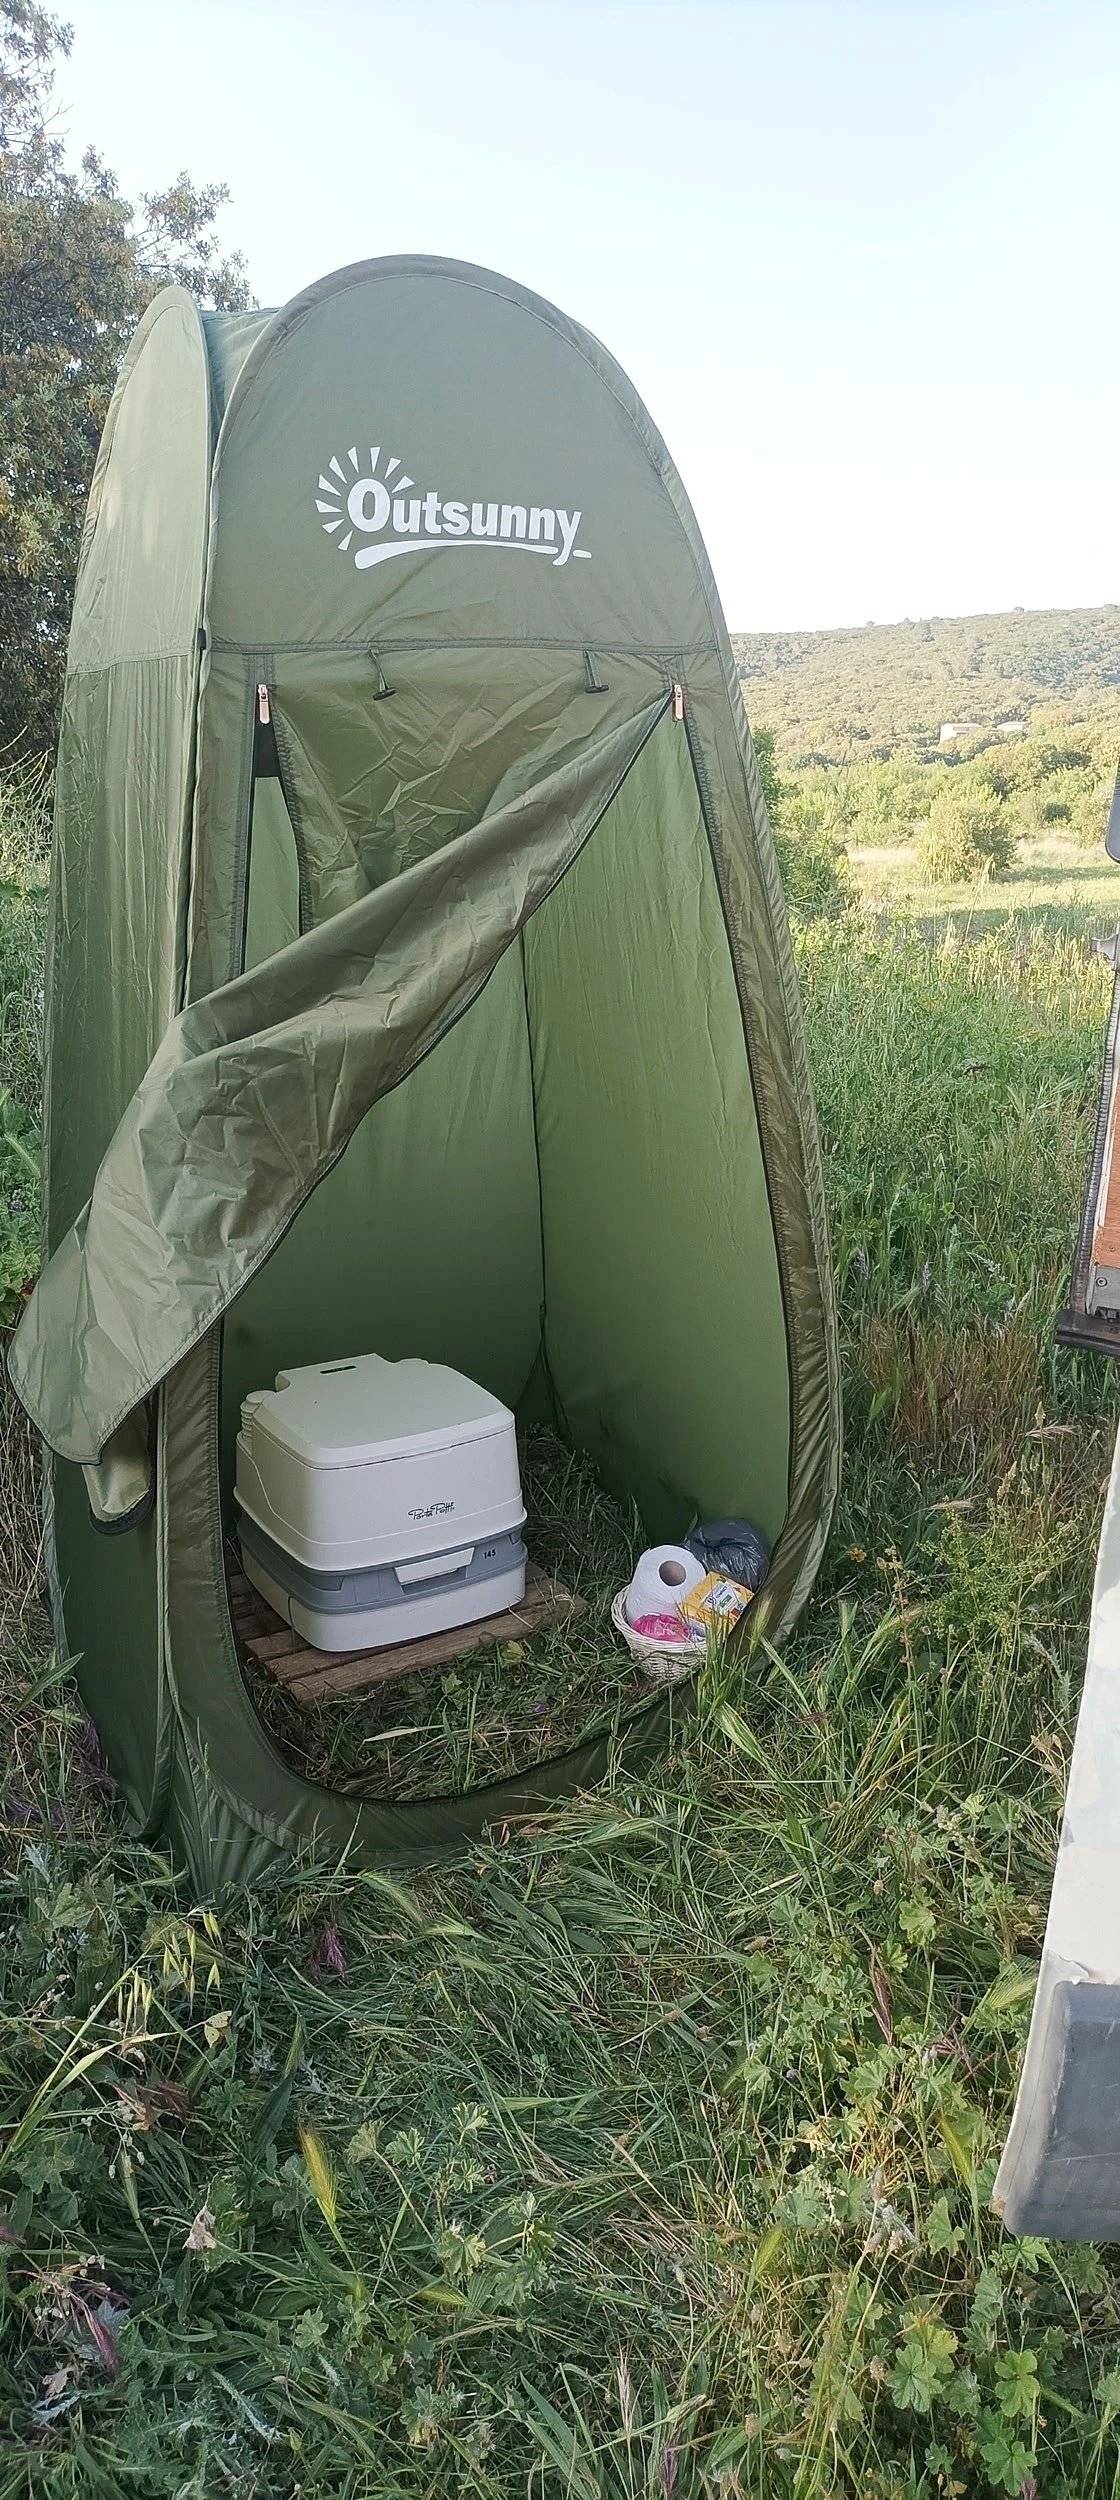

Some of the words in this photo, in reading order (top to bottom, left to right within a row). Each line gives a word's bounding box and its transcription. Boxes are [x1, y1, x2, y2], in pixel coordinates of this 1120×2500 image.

[347, 478, 582, 565] Outsunny
[408, 1508, 432, 1520] Porta
[483, 1548, 497, 1559] 145
